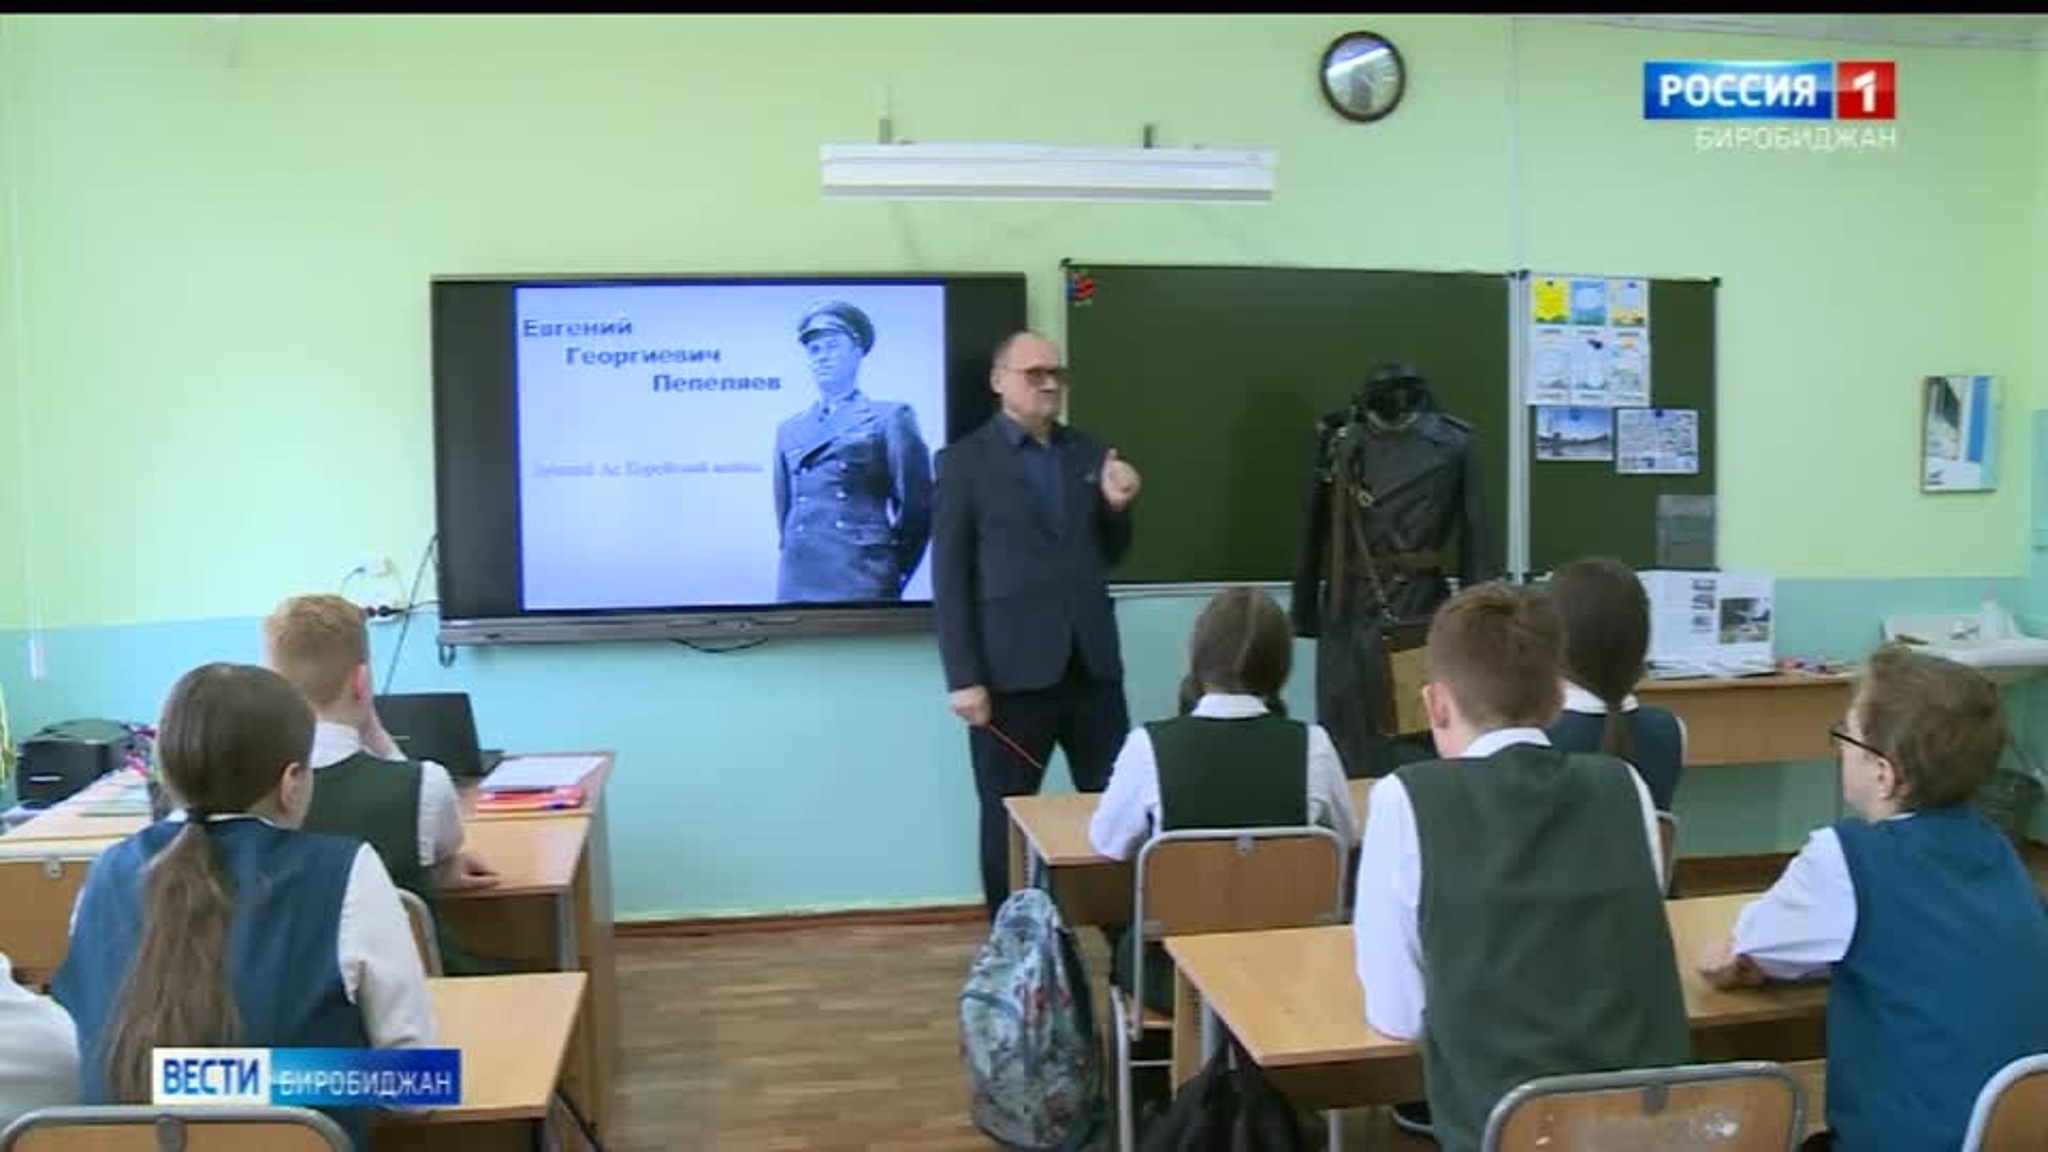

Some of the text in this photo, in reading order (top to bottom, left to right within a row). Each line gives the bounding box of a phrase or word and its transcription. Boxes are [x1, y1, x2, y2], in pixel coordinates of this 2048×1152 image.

[522, 317, 633, 338] Евгений
[566, 346, 722, 368] Георгиевич
[652, 374, 782, 393] Пепеляев
